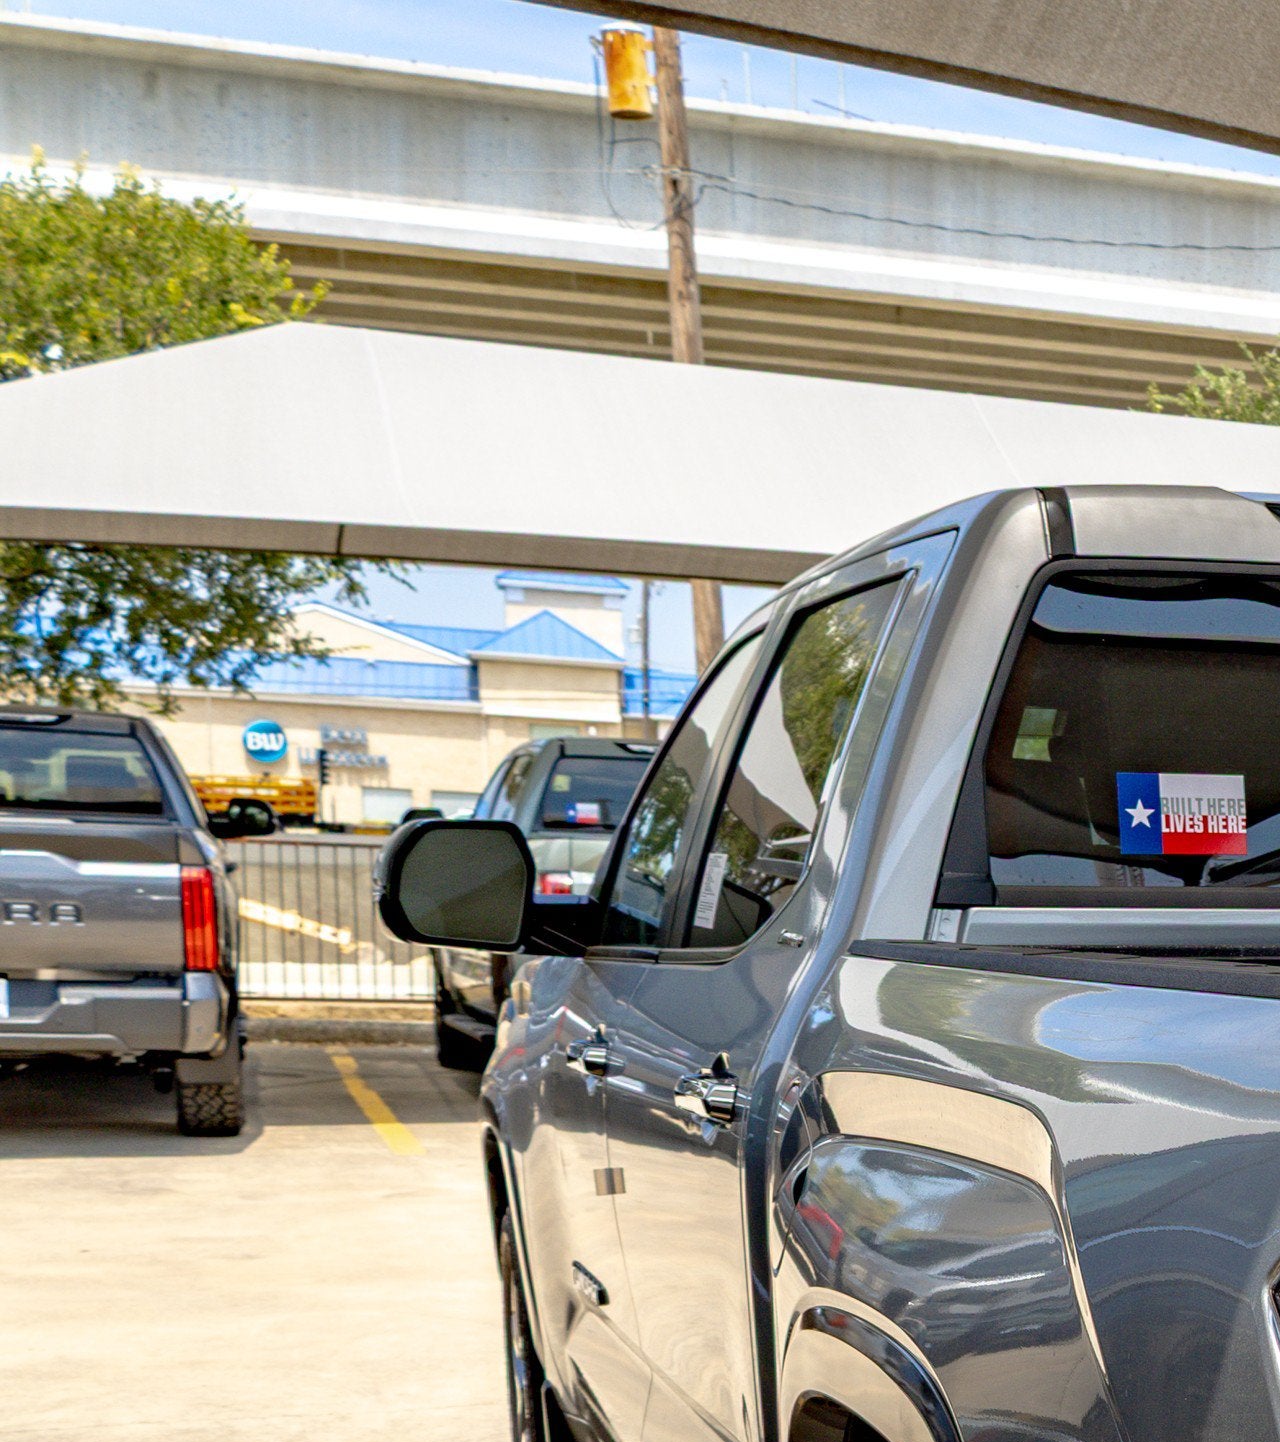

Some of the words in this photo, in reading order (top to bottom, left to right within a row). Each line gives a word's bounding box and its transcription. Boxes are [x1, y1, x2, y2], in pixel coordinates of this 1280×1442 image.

[246, 731, 285, 751] BW
[1160, 797, 1203, 816] BUILT
[1206, 798, 1247, 816] HERE
[1161, 814, 1205, 834] LIVES
[1207, 815, 1248, 834] HERE
